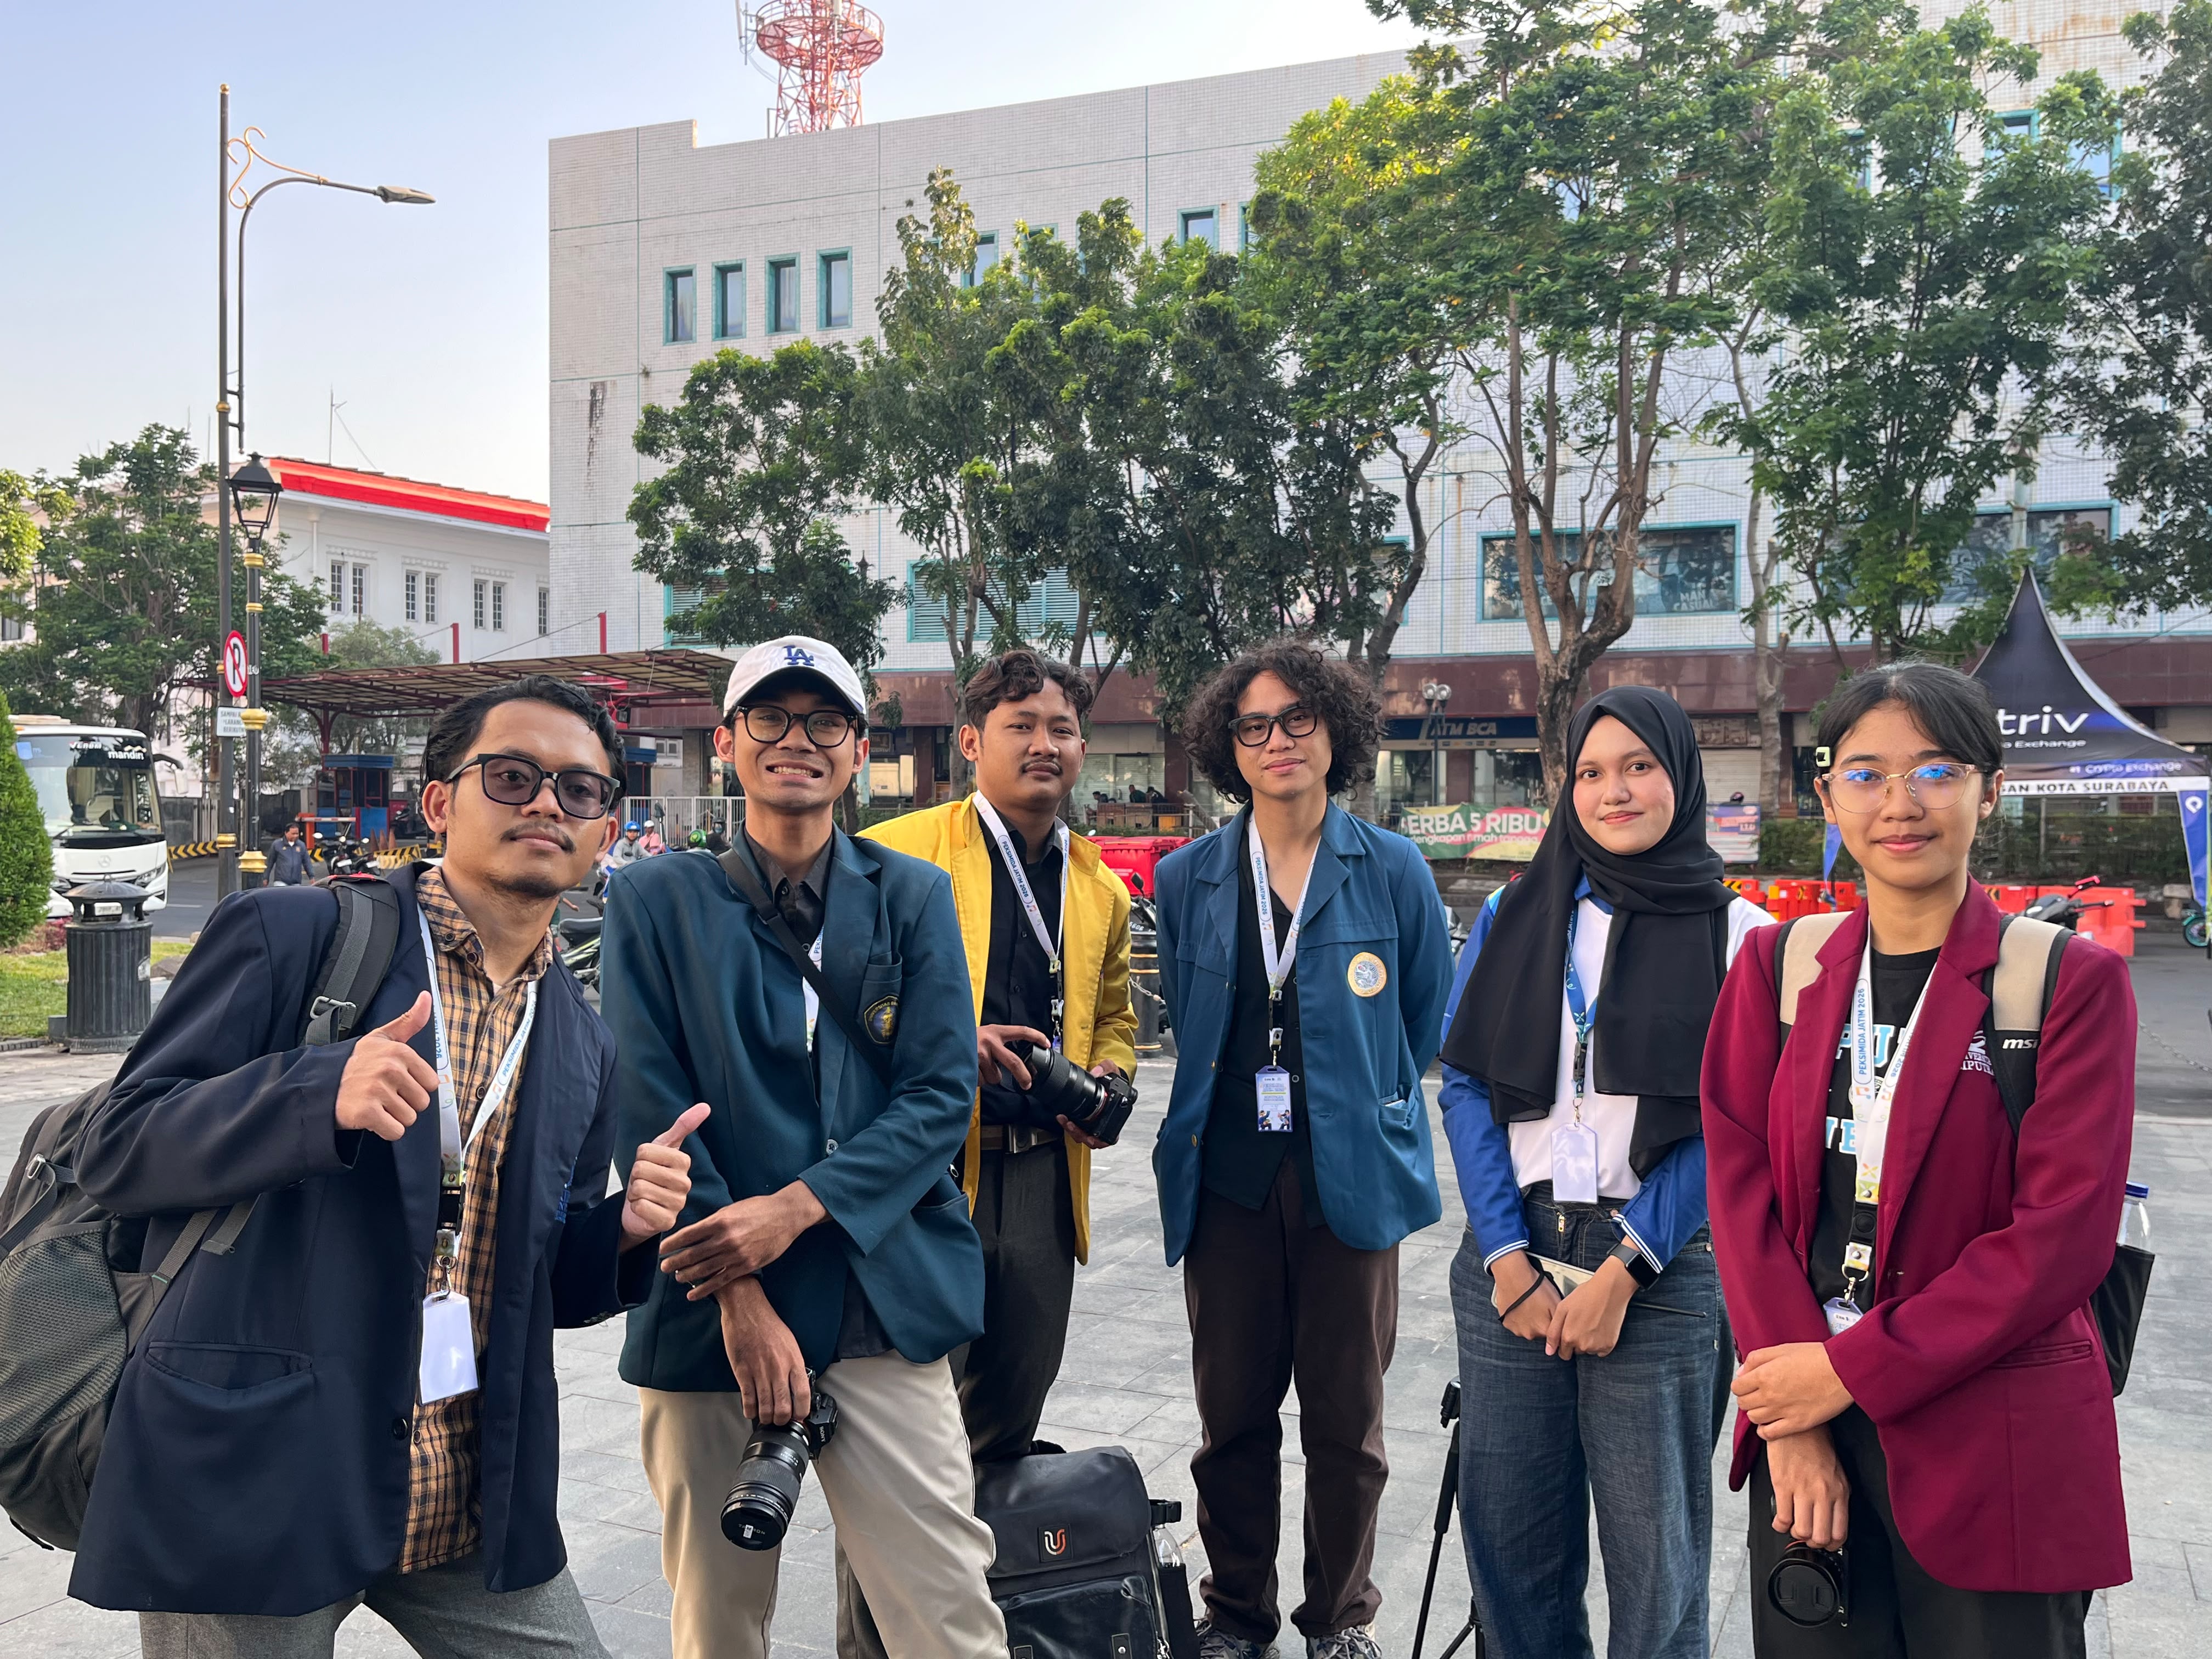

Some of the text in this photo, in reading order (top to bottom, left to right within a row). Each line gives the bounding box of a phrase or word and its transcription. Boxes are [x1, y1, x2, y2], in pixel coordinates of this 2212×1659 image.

[1680, 589, 1706, 602] MAN
[784, 645, 815, 667] LA
[1431, 722, 1497, 736] ATM BCA
[1997, 706, 2089, 735] triv
[2015, 740, 2086, 748] Exchange
[2085, 763, 2123, 774] Crypto
[2125, 761, 2182, 773] Exchange
[2037, 783, 2076, 792] KOTA
[2084, 780, 2169, 791] SURABAYA
[1470, 812, 1480, 832] 5
[1486, 813, 1542, 833] RIBU
[1013, 867, 1023, 884] JATIM
[1019, 884, 1029, 898] 2026
[1858, 1011, 1866, 1032] JATIM
[1858, 1032, 1867, 1075] PEKSIMIDA
[2002, 1039, 2038, 1049] msi
[502, 1039, 522, 1077] PEKSIMIDA
[1891, 1057, 1904, 1077] 2026
